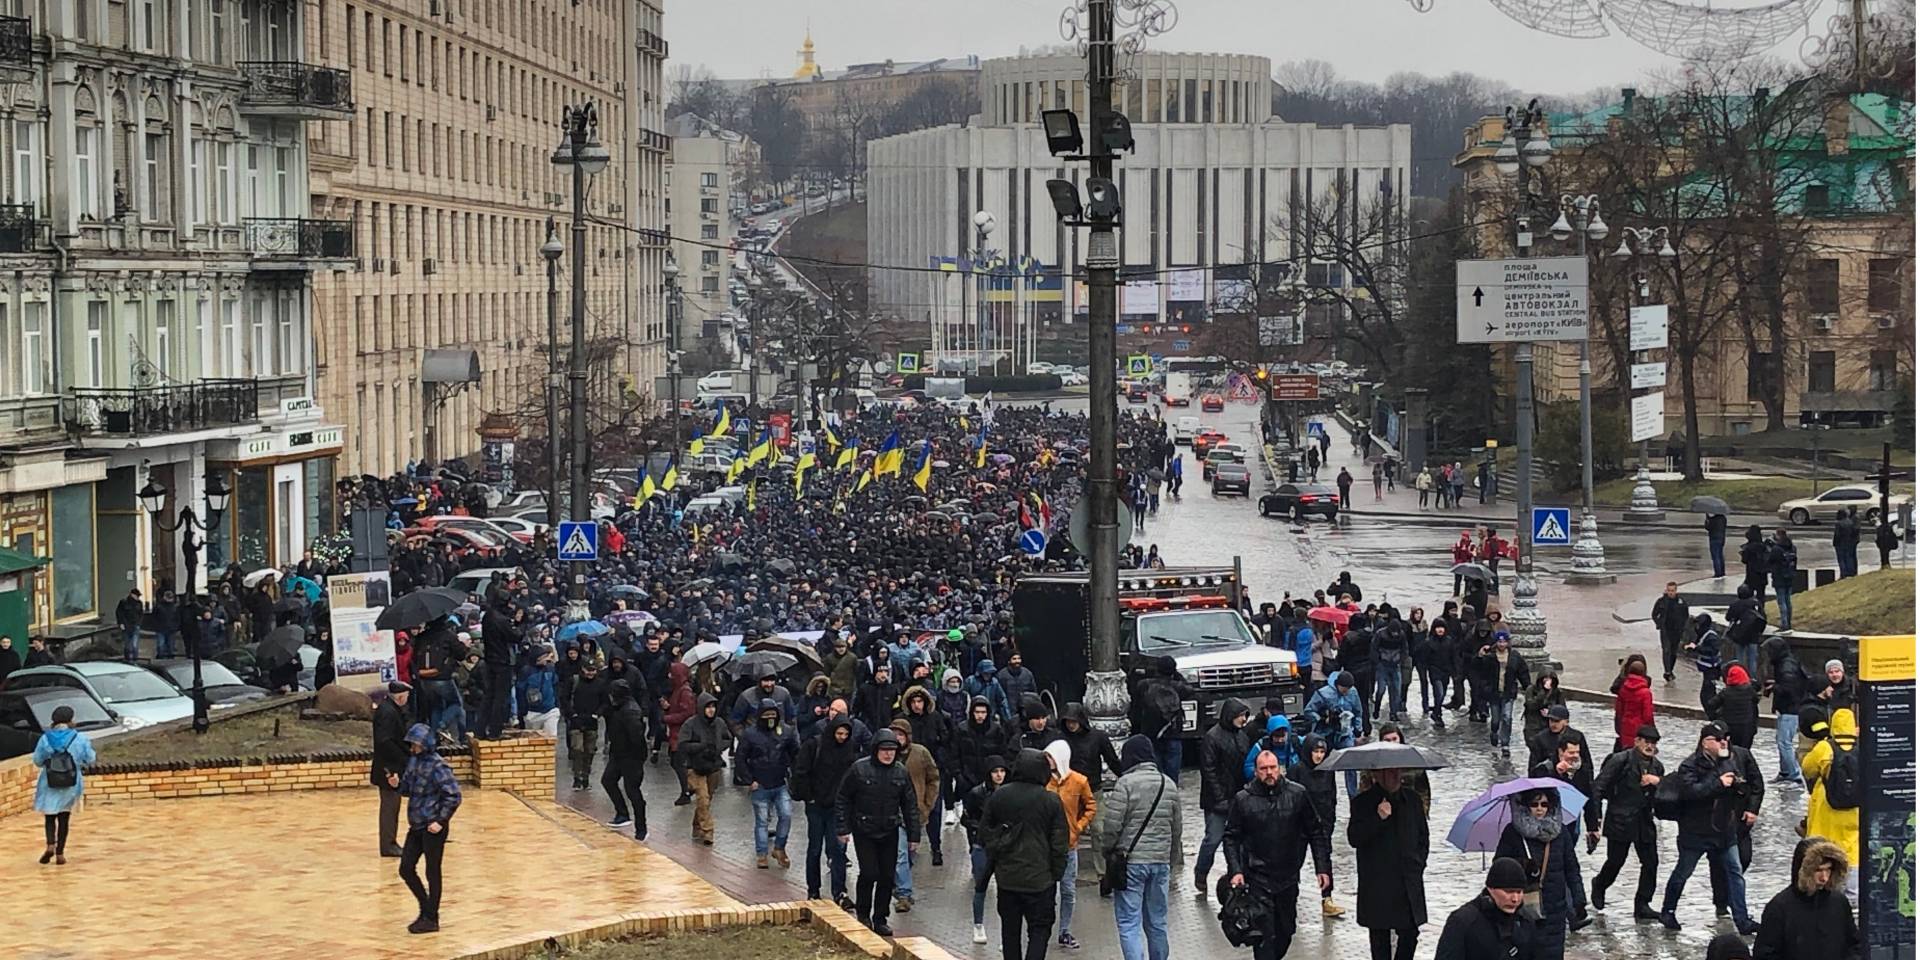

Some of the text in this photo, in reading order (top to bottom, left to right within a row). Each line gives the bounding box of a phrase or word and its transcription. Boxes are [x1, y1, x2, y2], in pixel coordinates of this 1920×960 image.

[1504, 271, 1569, 282] ДЕМІЇВСЬКА
[1504, 290, 1571, 300] центральний
[1505, 300, 1579, 310] АВТОВОКЗАЛ
[1505, 320, 1556, 330] аеропорт
[287, 399, 312, 411] CAPITAL
